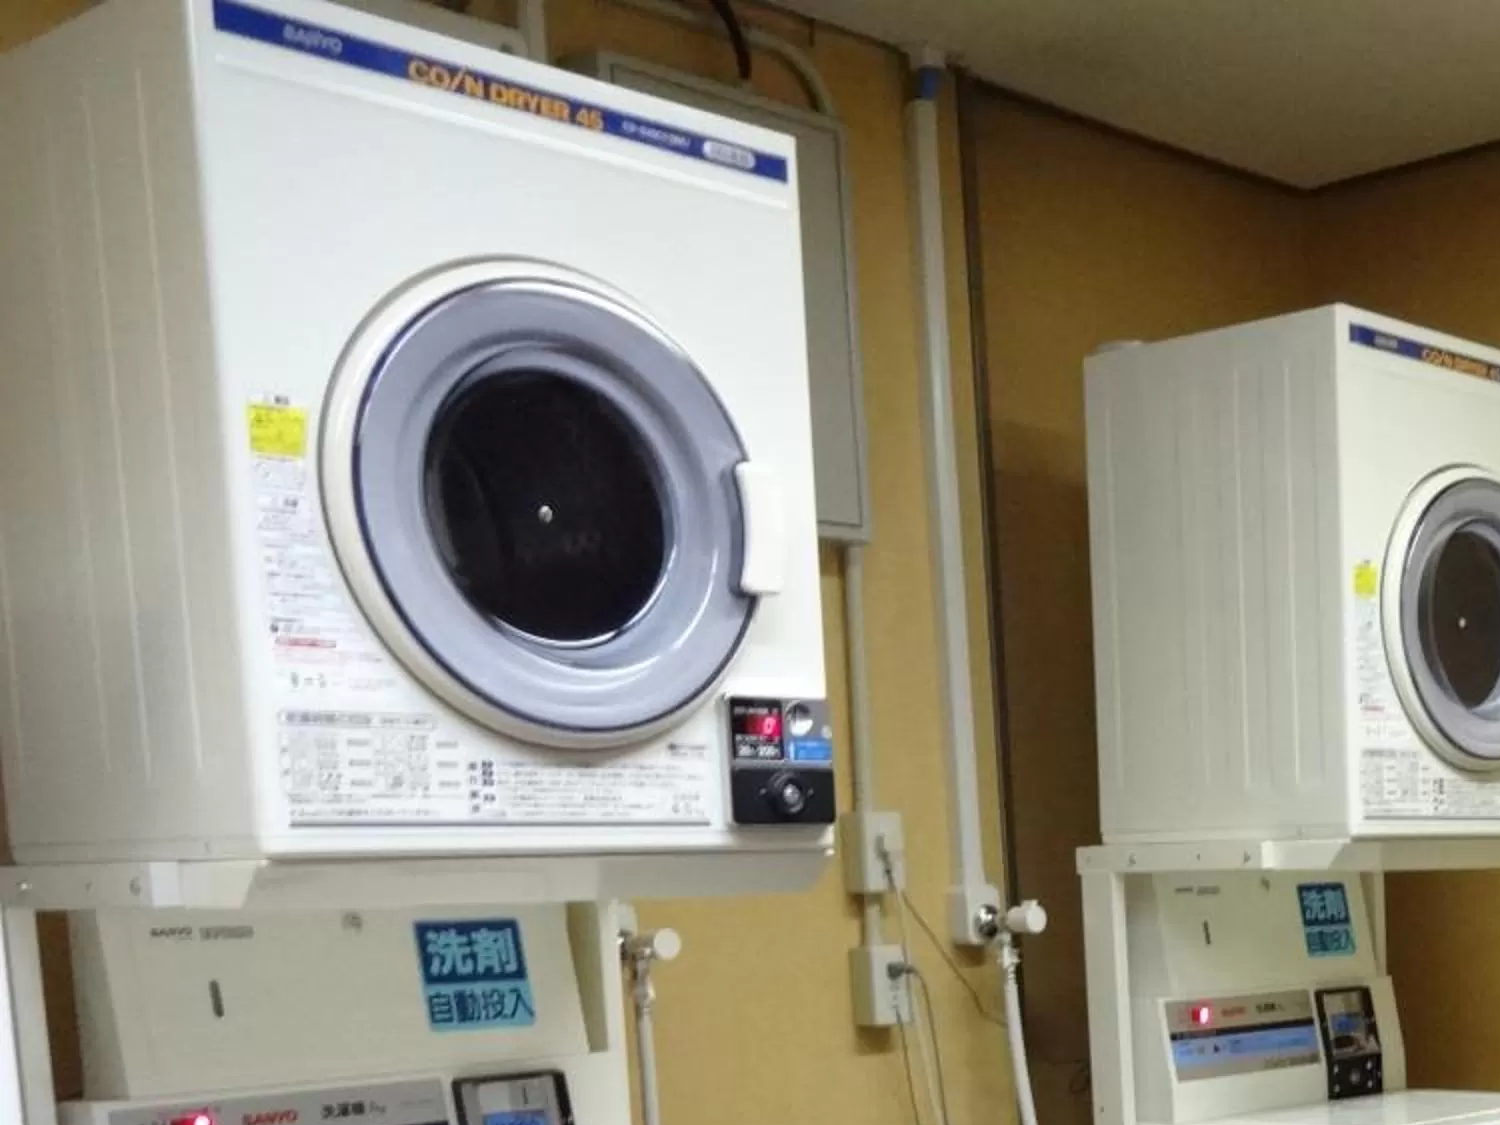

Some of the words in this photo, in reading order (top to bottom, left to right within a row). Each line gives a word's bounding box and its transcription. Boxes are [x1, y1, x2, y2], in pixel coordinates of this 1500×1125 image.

[489, 82, 571, 122] DRYER
[426, 927, 519, 976] 洗剤
[427, 985, 535, 1026] 自動投入
